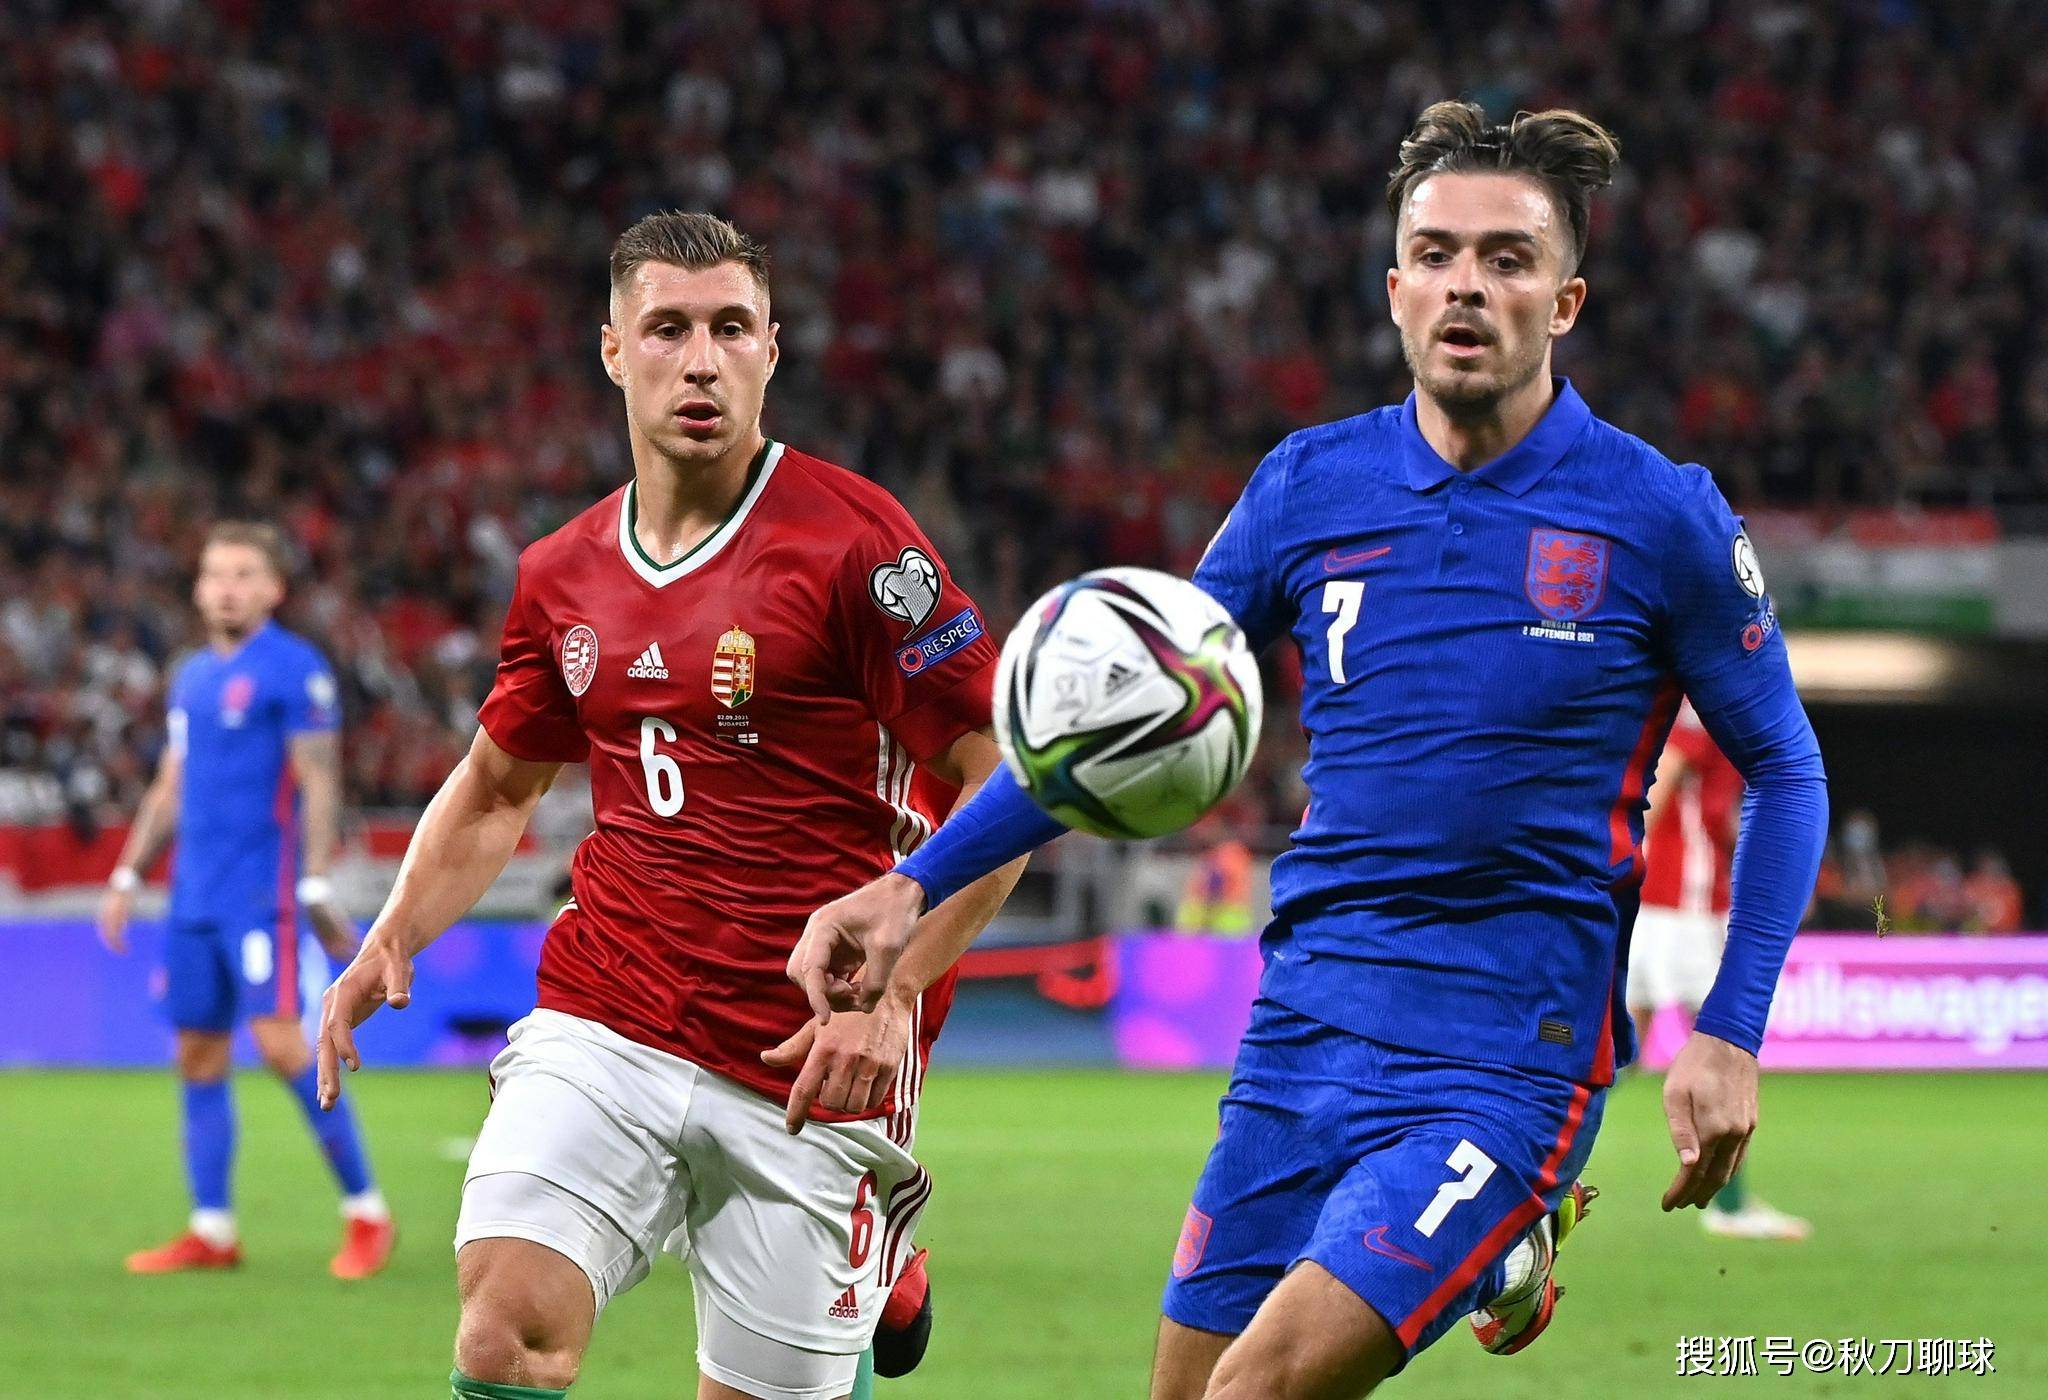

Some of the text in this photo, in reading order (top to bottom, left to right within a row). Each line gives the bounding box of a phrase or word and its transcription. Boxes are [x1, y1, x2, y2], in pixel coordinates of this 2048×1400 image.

[922, 614, 979, 658] RESPECT
[1321, 580, 1366, 685] 7
[1522, 626, 1595, 642] 2 SEPTEMBER 2021
[1541, 620, 1577, 631] HUNGARY
[626, 665, 670, 680] adidas
[639, 716, 686, 818] 6
[1413, 1138, 1498, 1239] 7
[848, 1169, 878, 1270] 6
[828, 1305, 860, 1319] adidas
